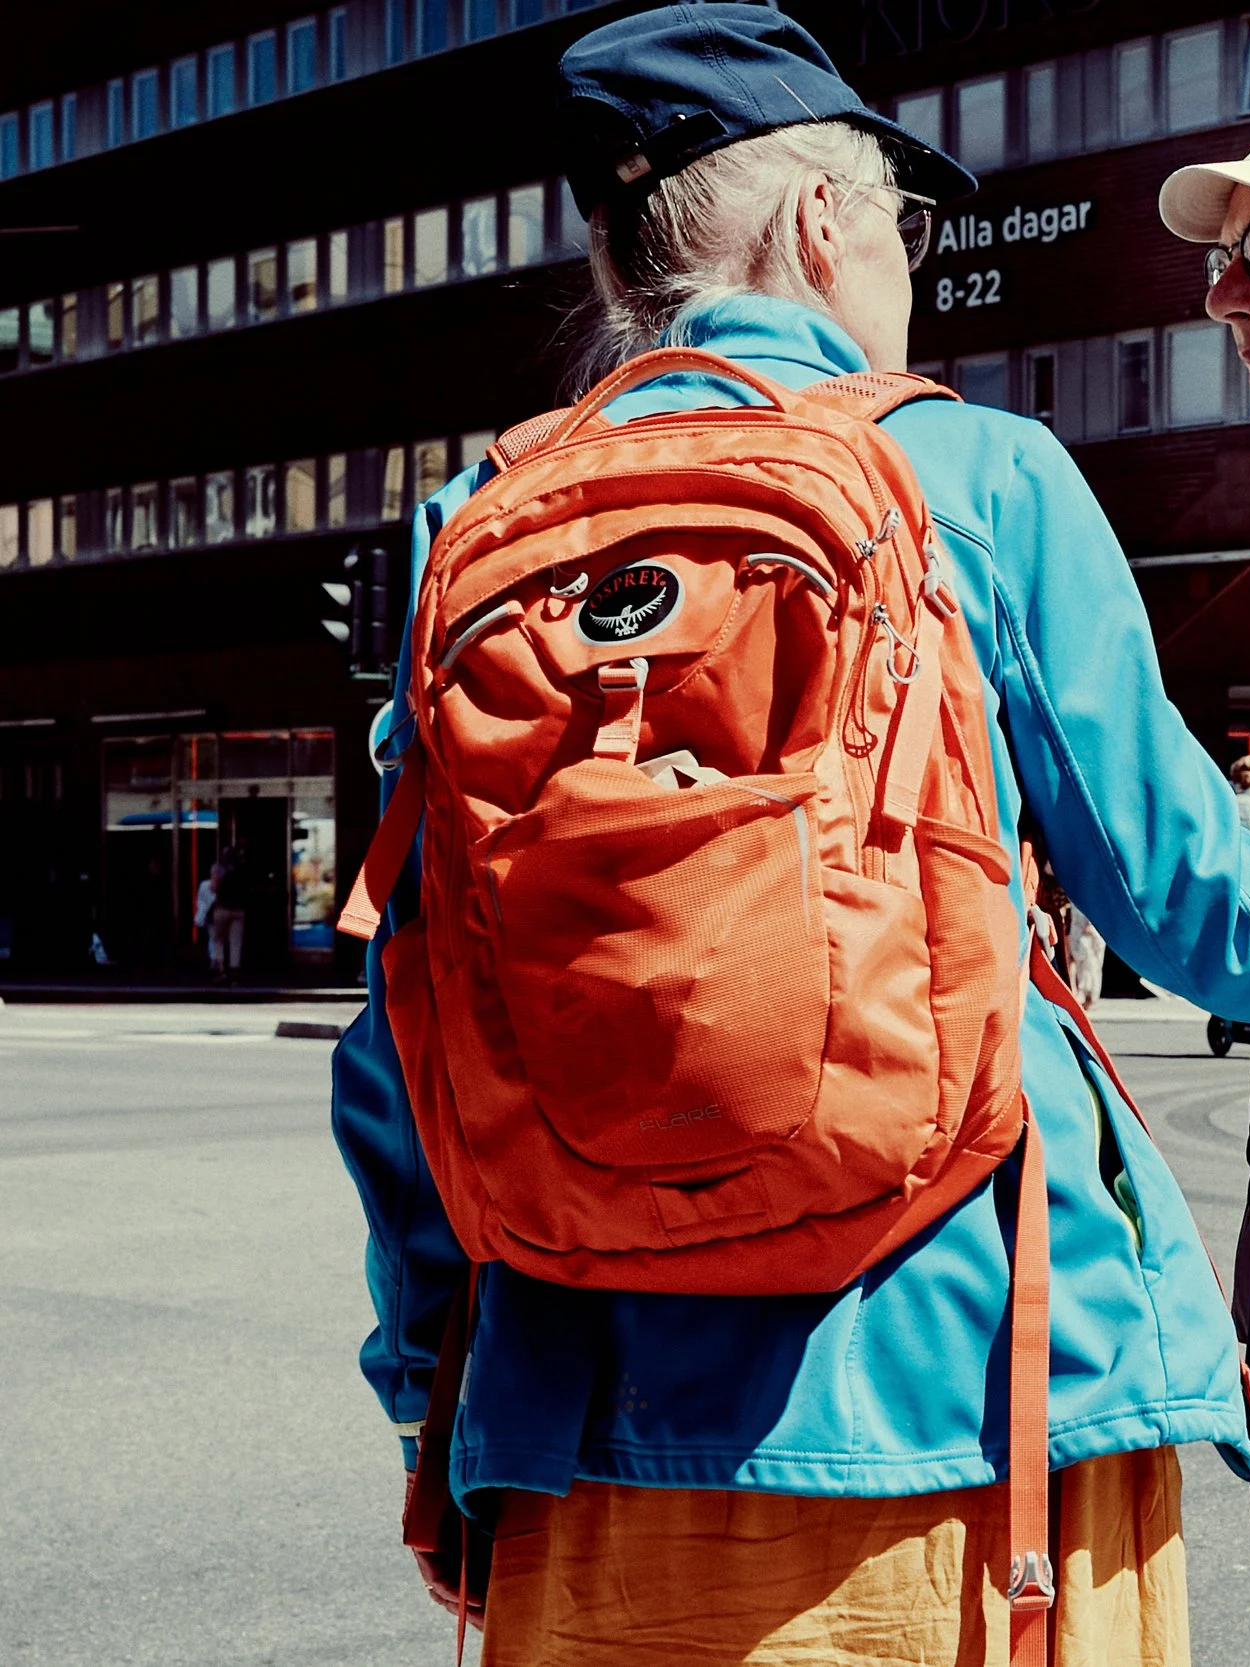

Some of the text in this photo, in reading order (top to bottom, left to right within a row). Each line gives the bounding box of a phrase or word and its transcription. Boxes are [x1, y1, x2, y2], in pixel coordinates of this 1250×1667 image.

[937, 201, 1092, 254] Alla dagar
[936, 269, 1002, 312] 8-22
